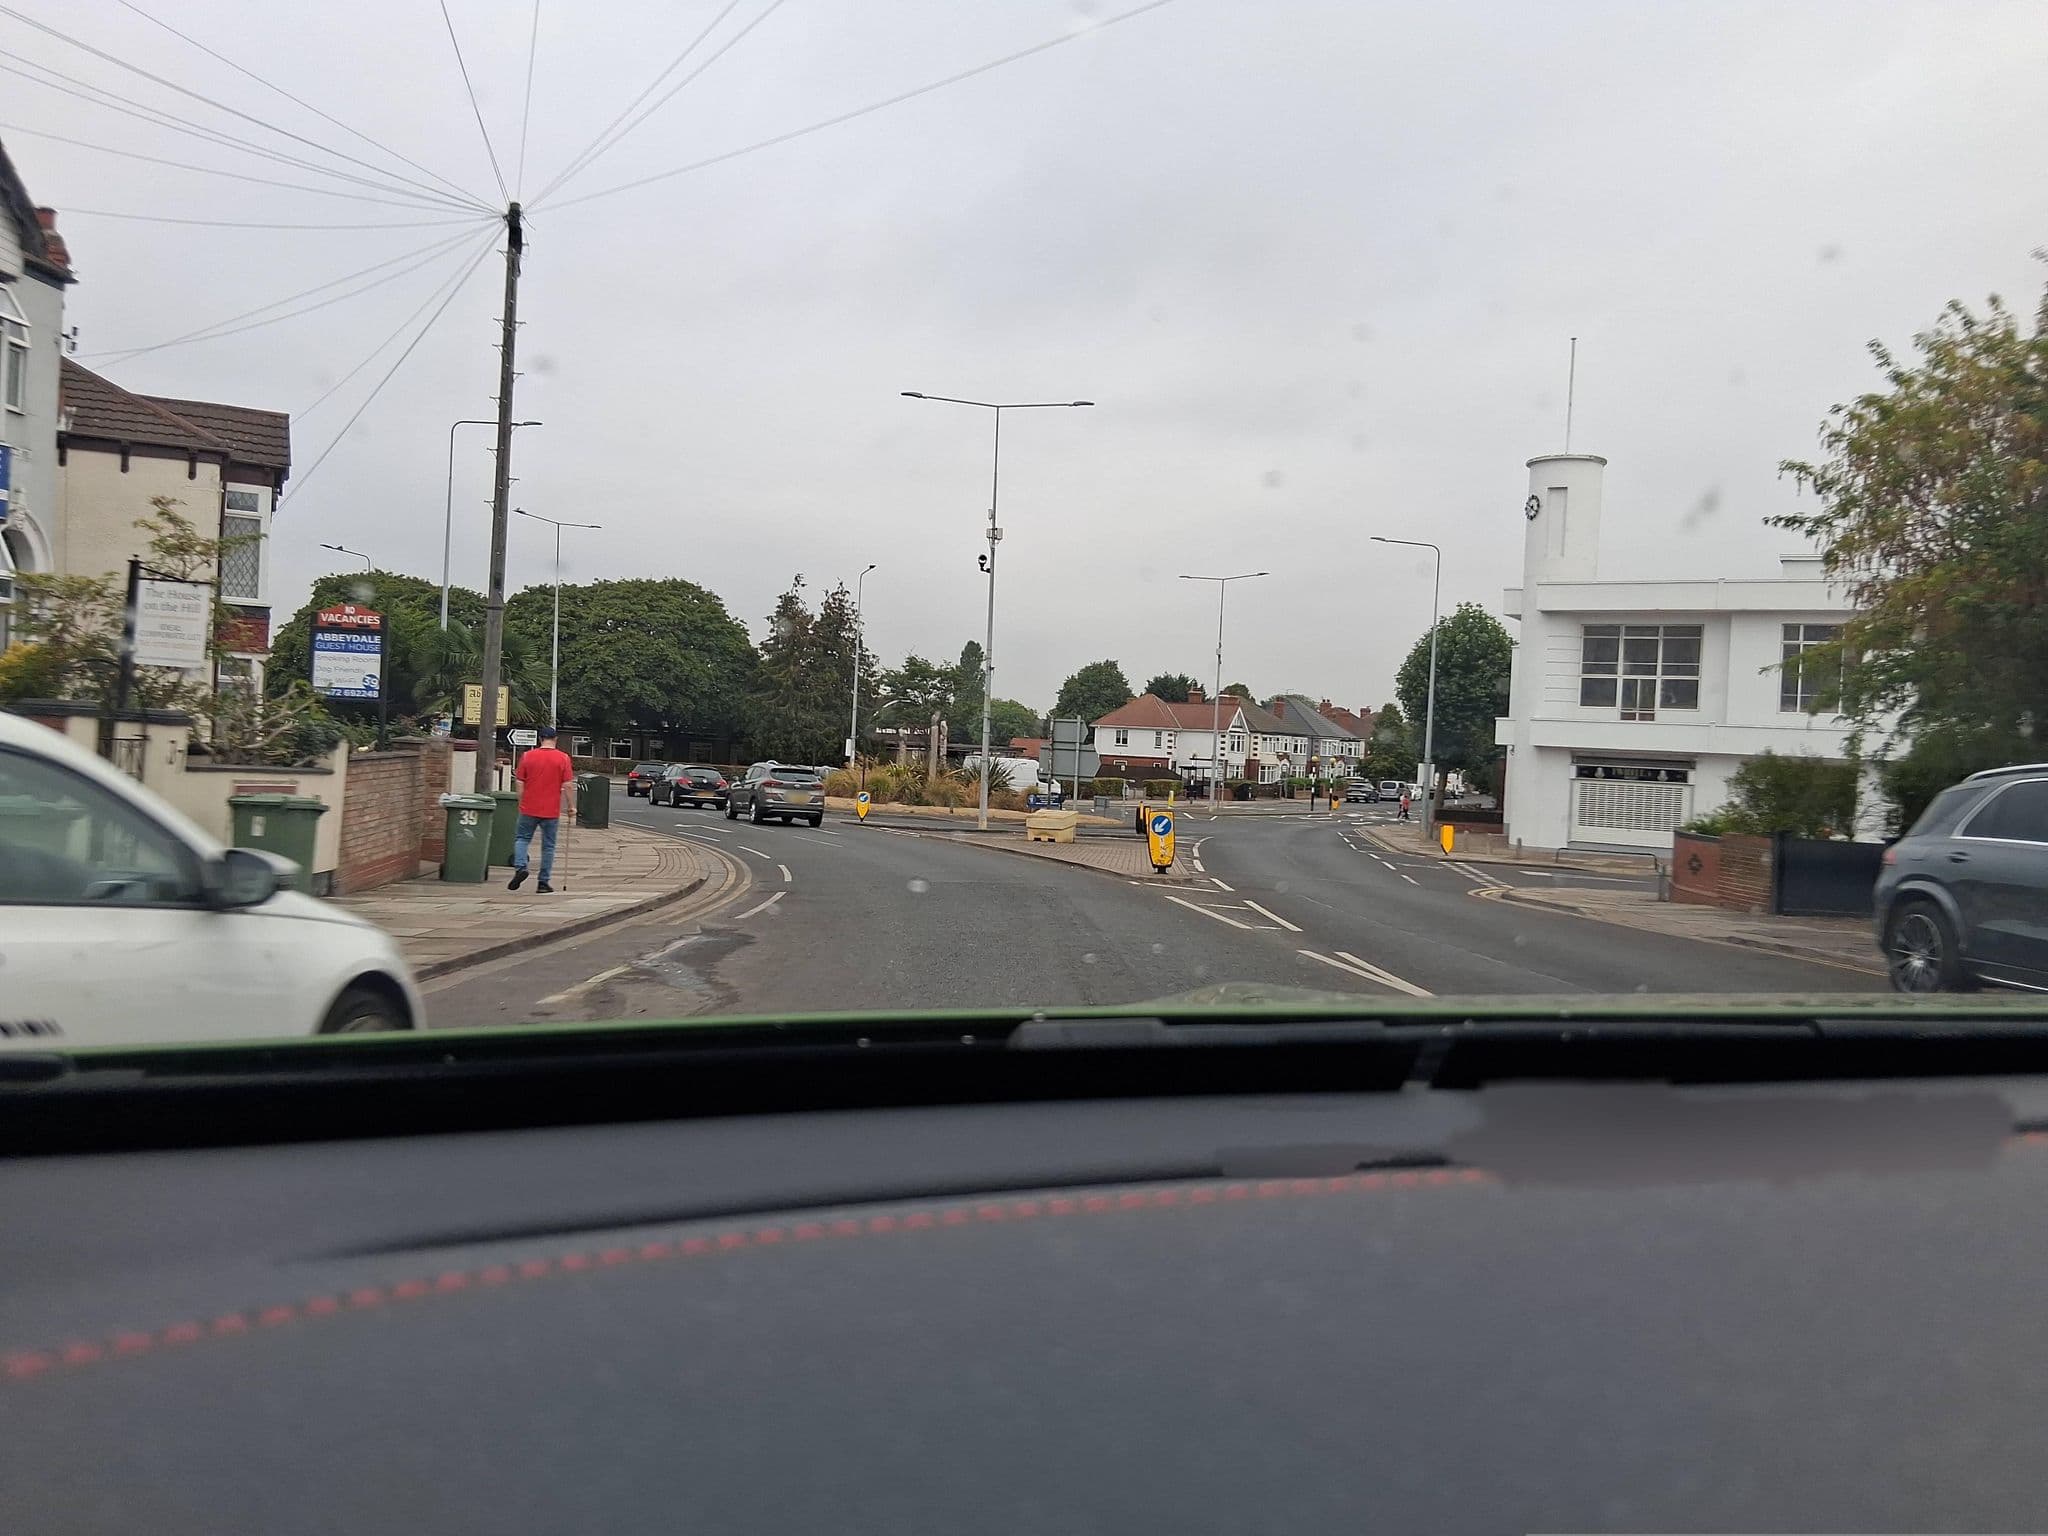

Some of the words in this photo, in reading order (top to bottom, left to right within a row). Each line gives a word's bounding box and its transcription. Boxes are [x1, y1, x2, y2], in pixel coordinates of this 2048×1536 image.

[321, 613, 380, 624] VACANCIES
[316, 633, 381, 644] ABBEYDALE
[316, 642, 346, 650] GUEST
[350, 643, 381, 652] HOUSE
[363, 676, 379, 687] 39
[459, 810, 478, 826] 39
